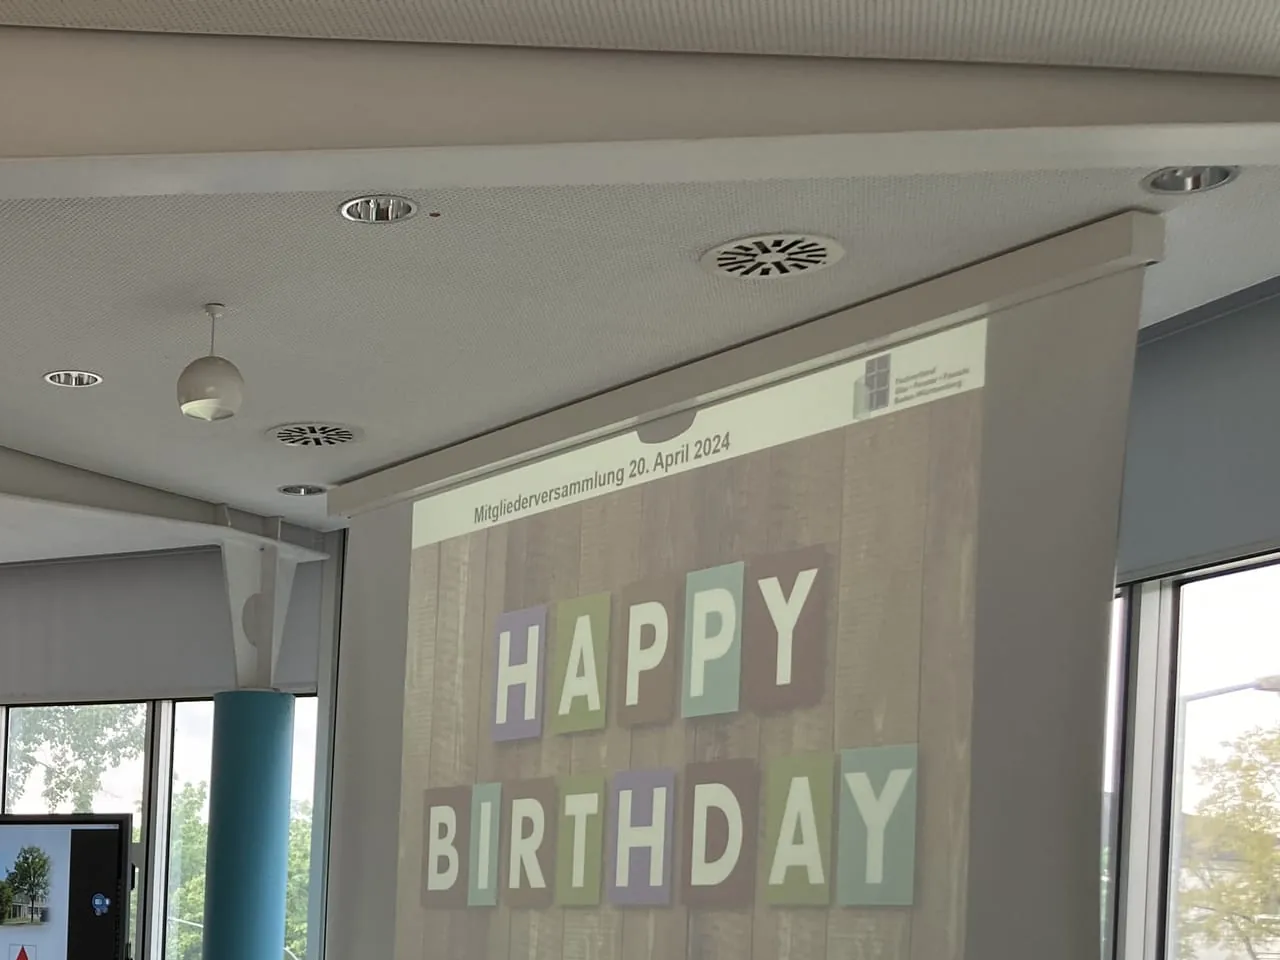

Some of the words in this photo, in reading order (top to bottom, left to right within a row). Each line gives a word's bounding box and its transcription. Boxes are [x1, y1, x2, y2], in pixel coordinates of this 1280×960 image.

[474, 468, 625, 524] Mitgliederversammlung
[628, 457, 650, 478] 20.
[653, 444, 689, 473] April
[694, 432, 731, 459] 2024
[495, 568, 818, 725] HAPPY
[427, 768, 913, 891] BIRTHDAY
